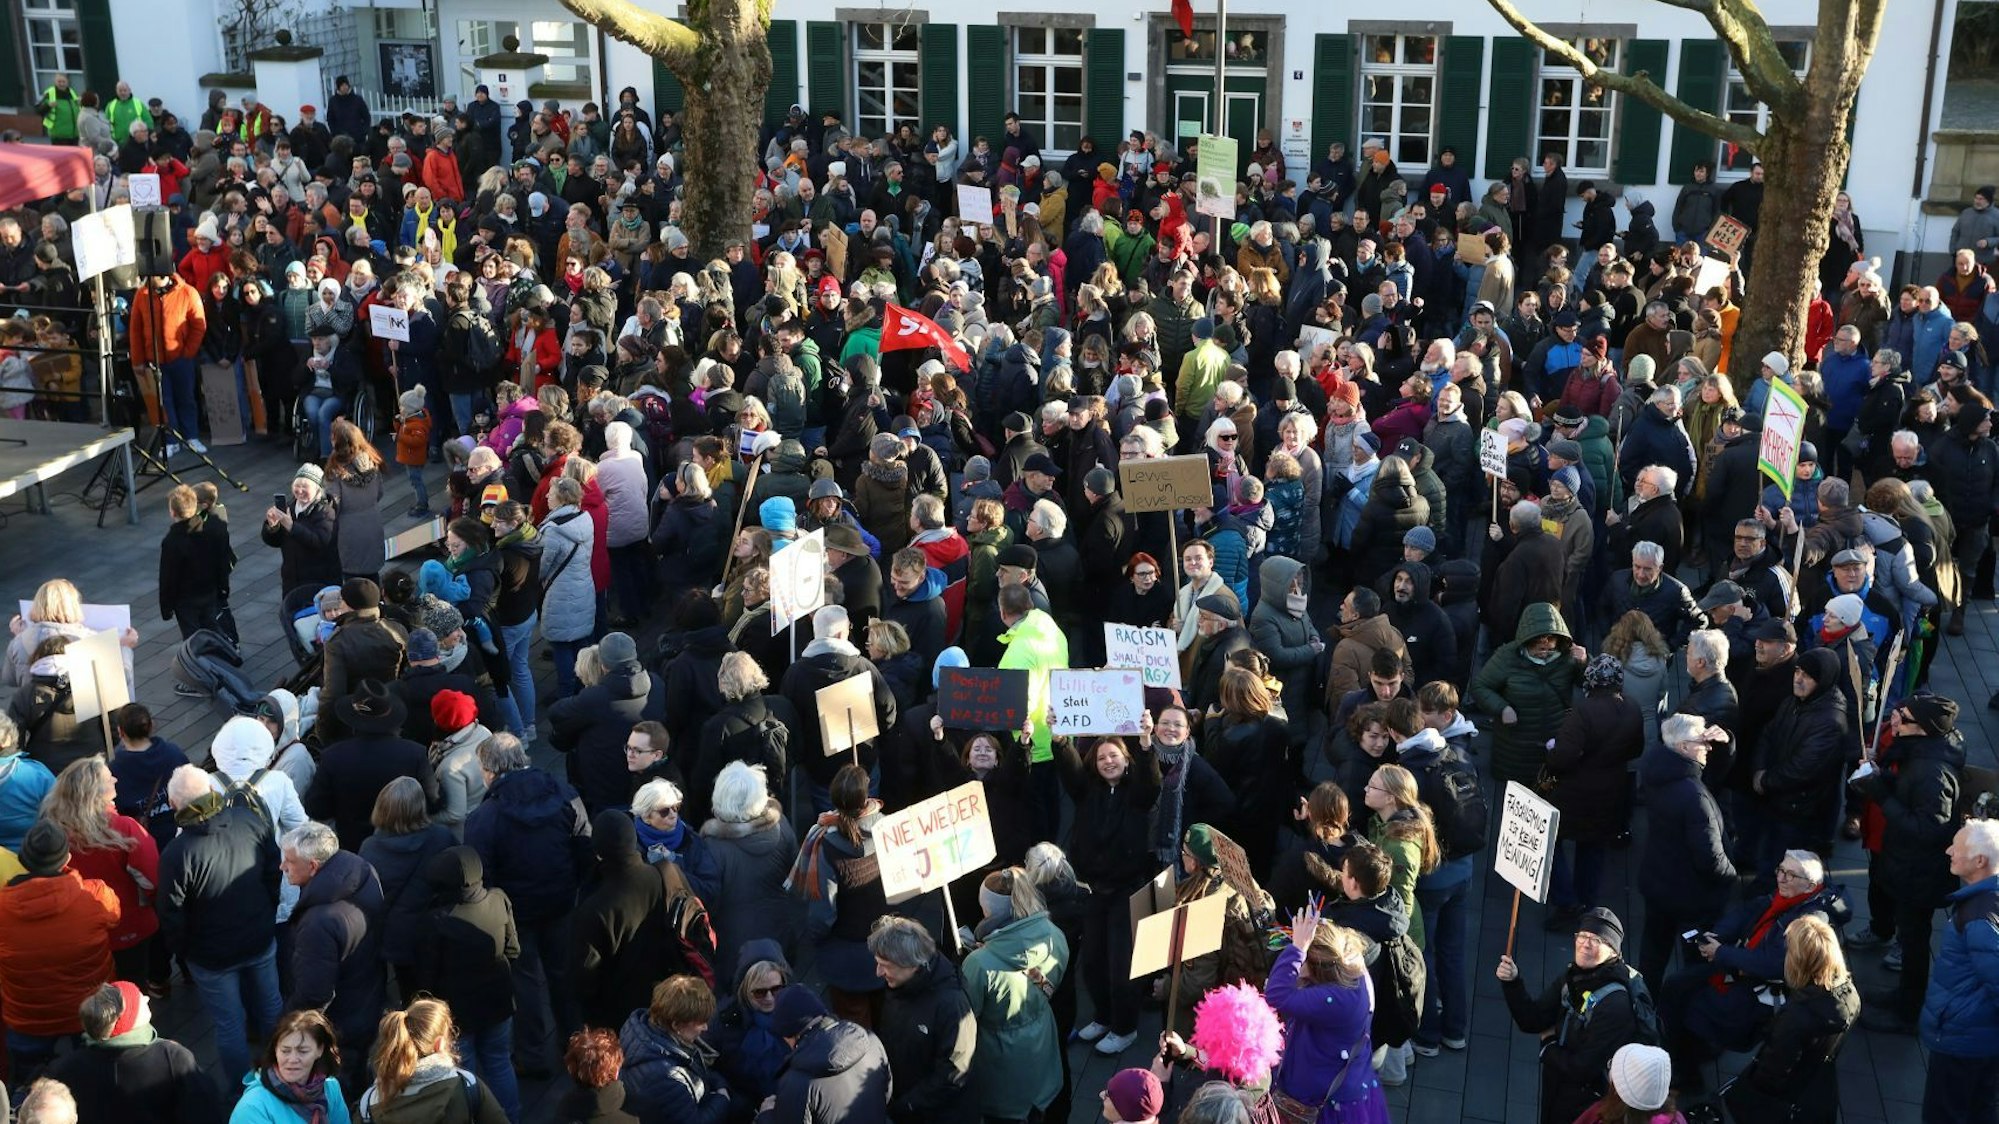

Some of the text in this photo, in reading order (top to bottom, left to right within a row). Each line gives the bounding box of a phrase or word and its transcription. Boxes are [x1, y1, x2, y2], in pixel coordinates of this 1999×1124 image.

[1157, 483, 1173, 492] un
[1115, 628, 1167, 648] RACISM
[1112, 651, 1172, 668] SMALL DICK
[1060, 714, 1091, 727] AFD
[882, 794, 981, 854] NIE WIEDER
